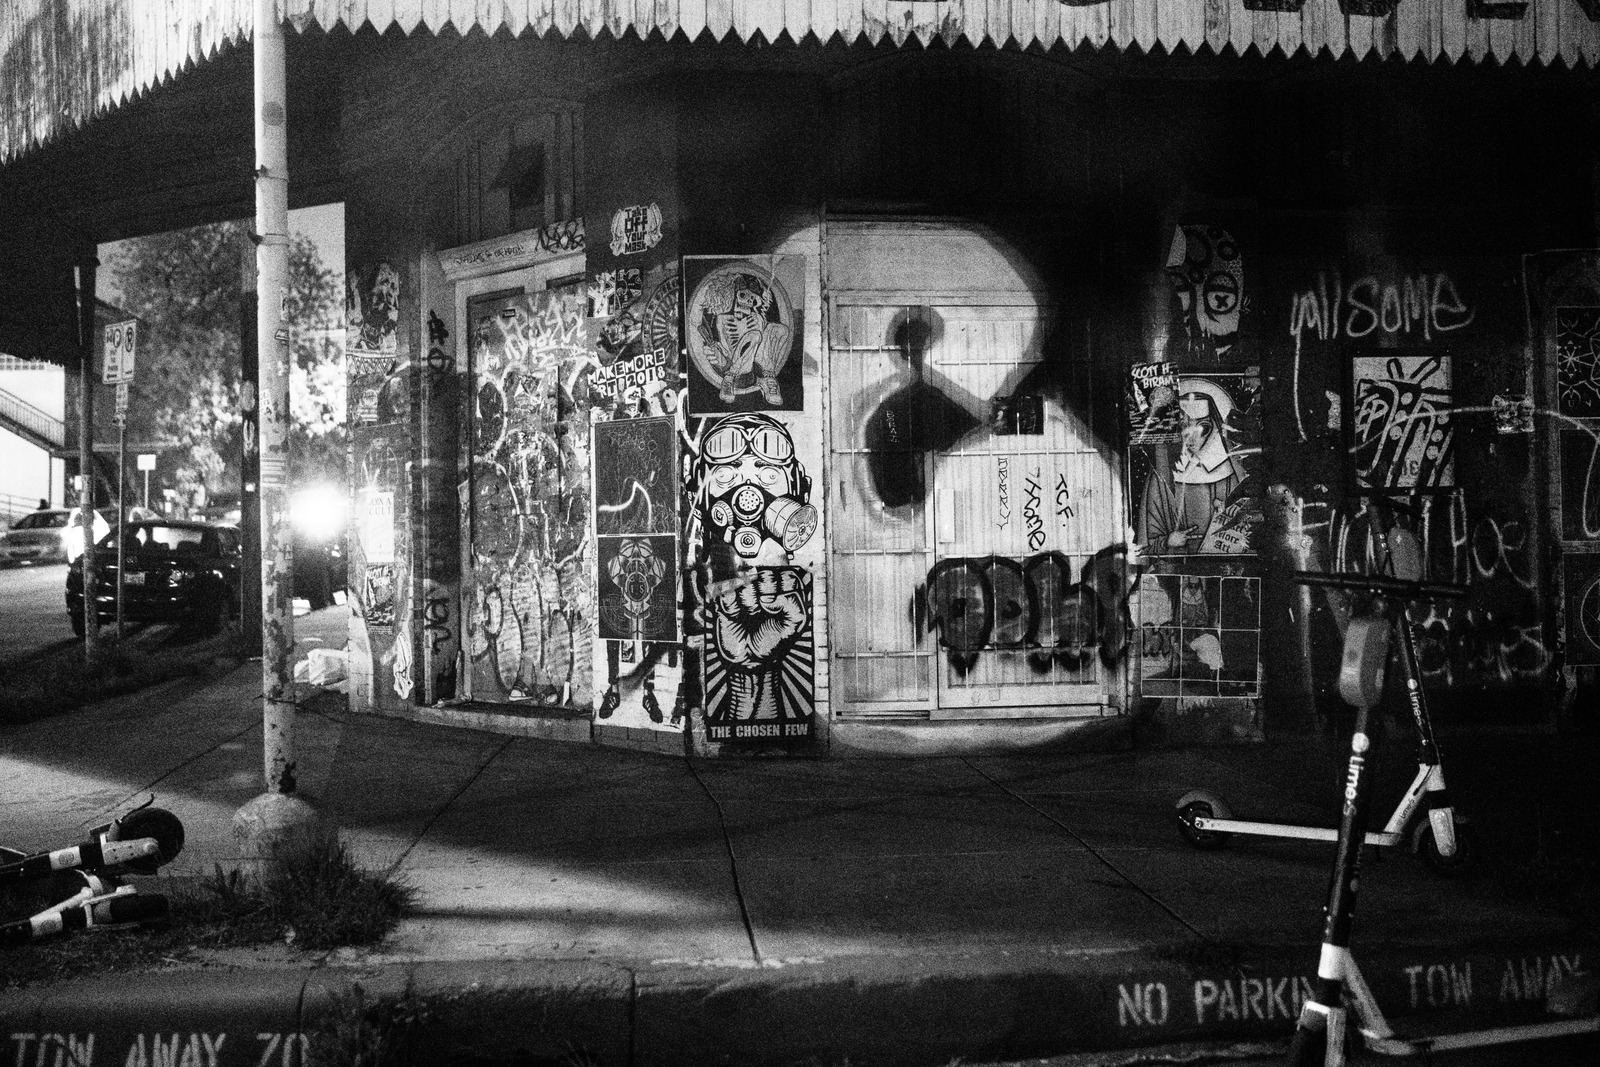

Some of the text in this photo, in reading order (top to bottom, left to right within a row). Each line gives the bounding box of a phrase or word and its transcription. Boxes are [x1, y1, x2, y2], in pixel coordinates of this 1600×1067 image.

[624, 207, 648, 219] Take
[624, 216, 648, 233] Off
[624, 231, 648, 244] Your
[624, 242, 647, 253] Mask
[1130, 364, 1159, 381] SCOTT
[386, 497, 392, 506] A
[368, 506, 393, 516] CULT
[710, 723, 808, 738] THE CHOSEN FEW
[1404, 962, 1472, 1008] TOW
[1117, 981, 1169, 1026] NO
[10, 1032, 95, 1067] TOW
[125, 1032, 227, 1067] AWAY
